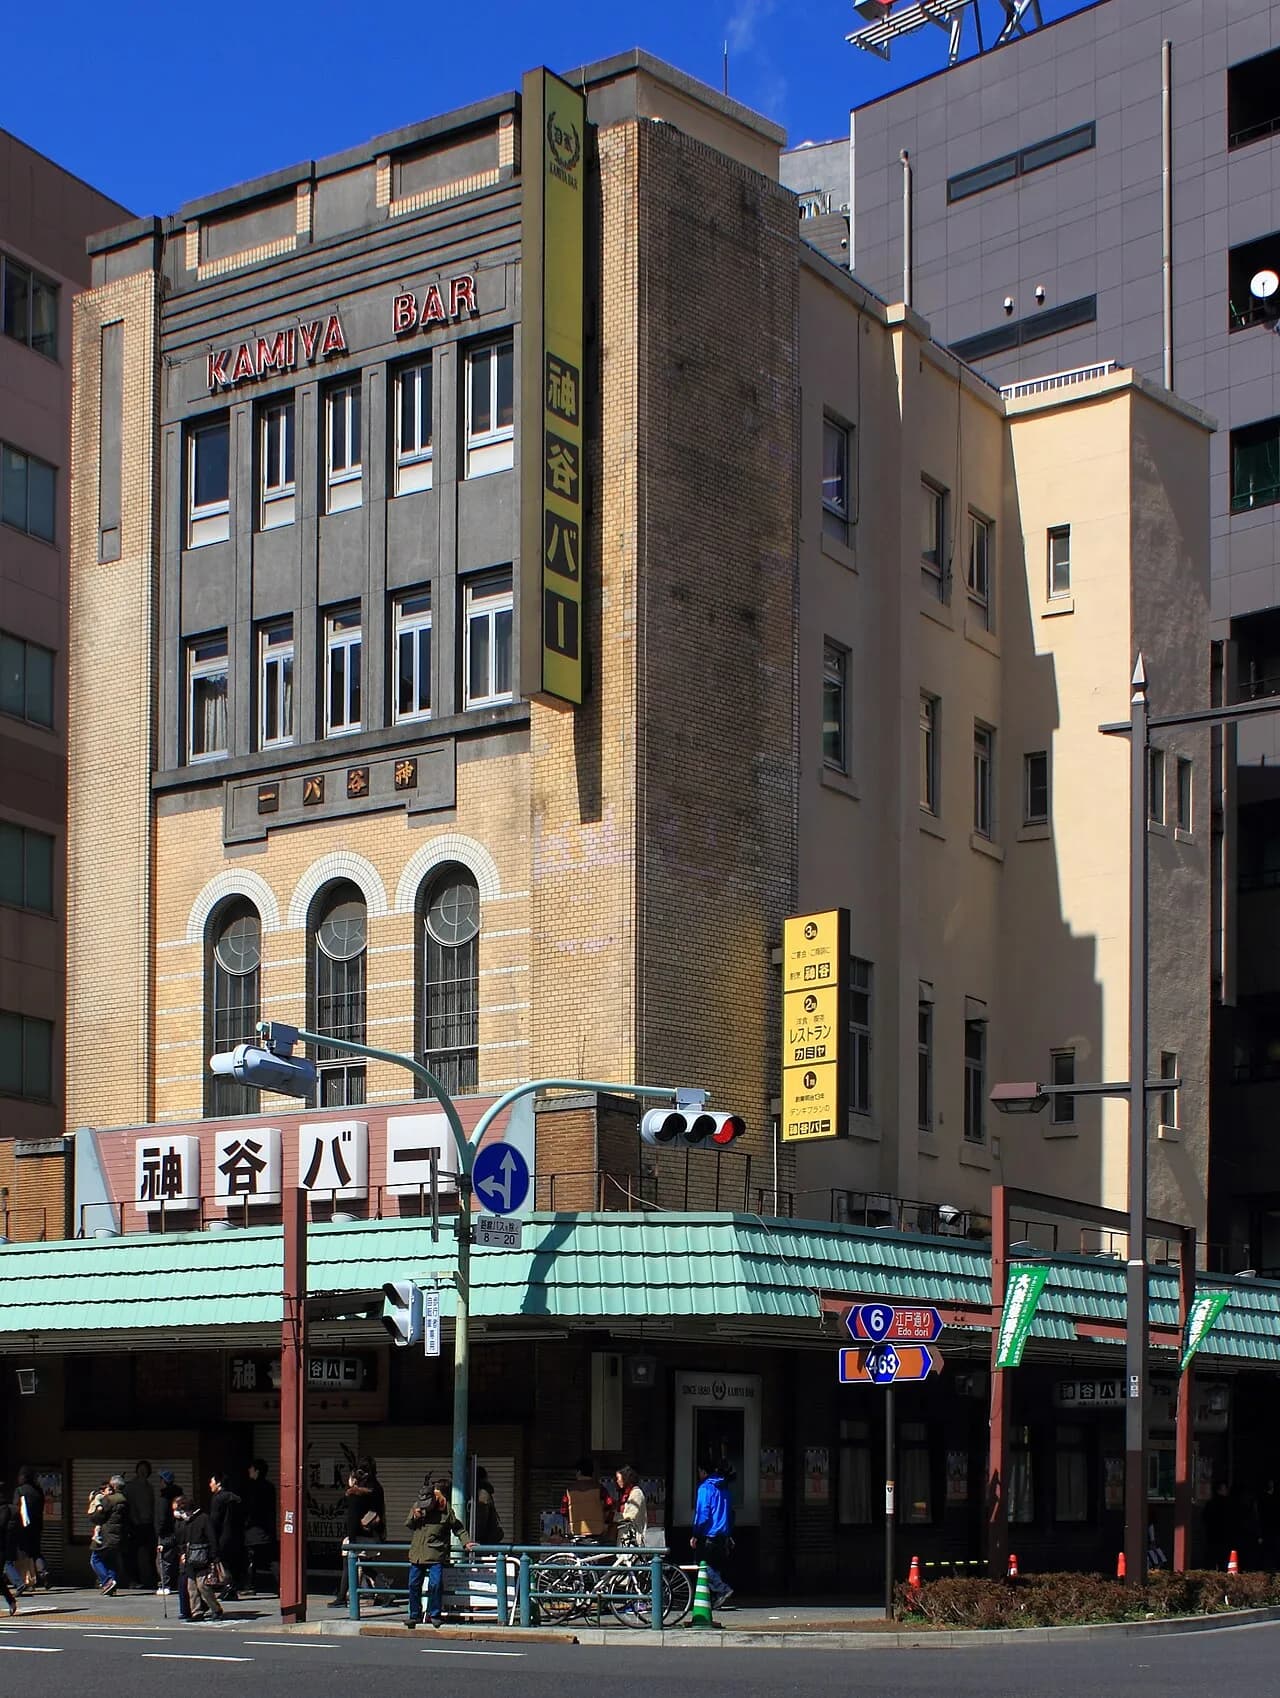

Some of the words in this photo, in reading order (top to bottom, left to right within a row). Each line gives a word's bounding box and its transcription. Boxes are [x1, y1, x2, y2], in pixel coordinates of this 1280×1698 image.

[206, 315, 346, 390] KAMIYA
[392, 275, 477, 335] BAR
[547, 364, 578, 648] 神谷バー
[790, 1025, 831, 1044] レストラン
[795, 1045, 825, 1061] カミヤ
[141, 1132, 441, 1199] 神谷バー
[504, 1234, 515, 1245] 20
[870, 1309, 884, 1332] 6
[895, 1311, 931, 1327] 江戸通り
[897, 1328, 912, 1336] Edo
[914, 1328, 929, 1337] dori
[868, 1353, 896, 1375] 463
